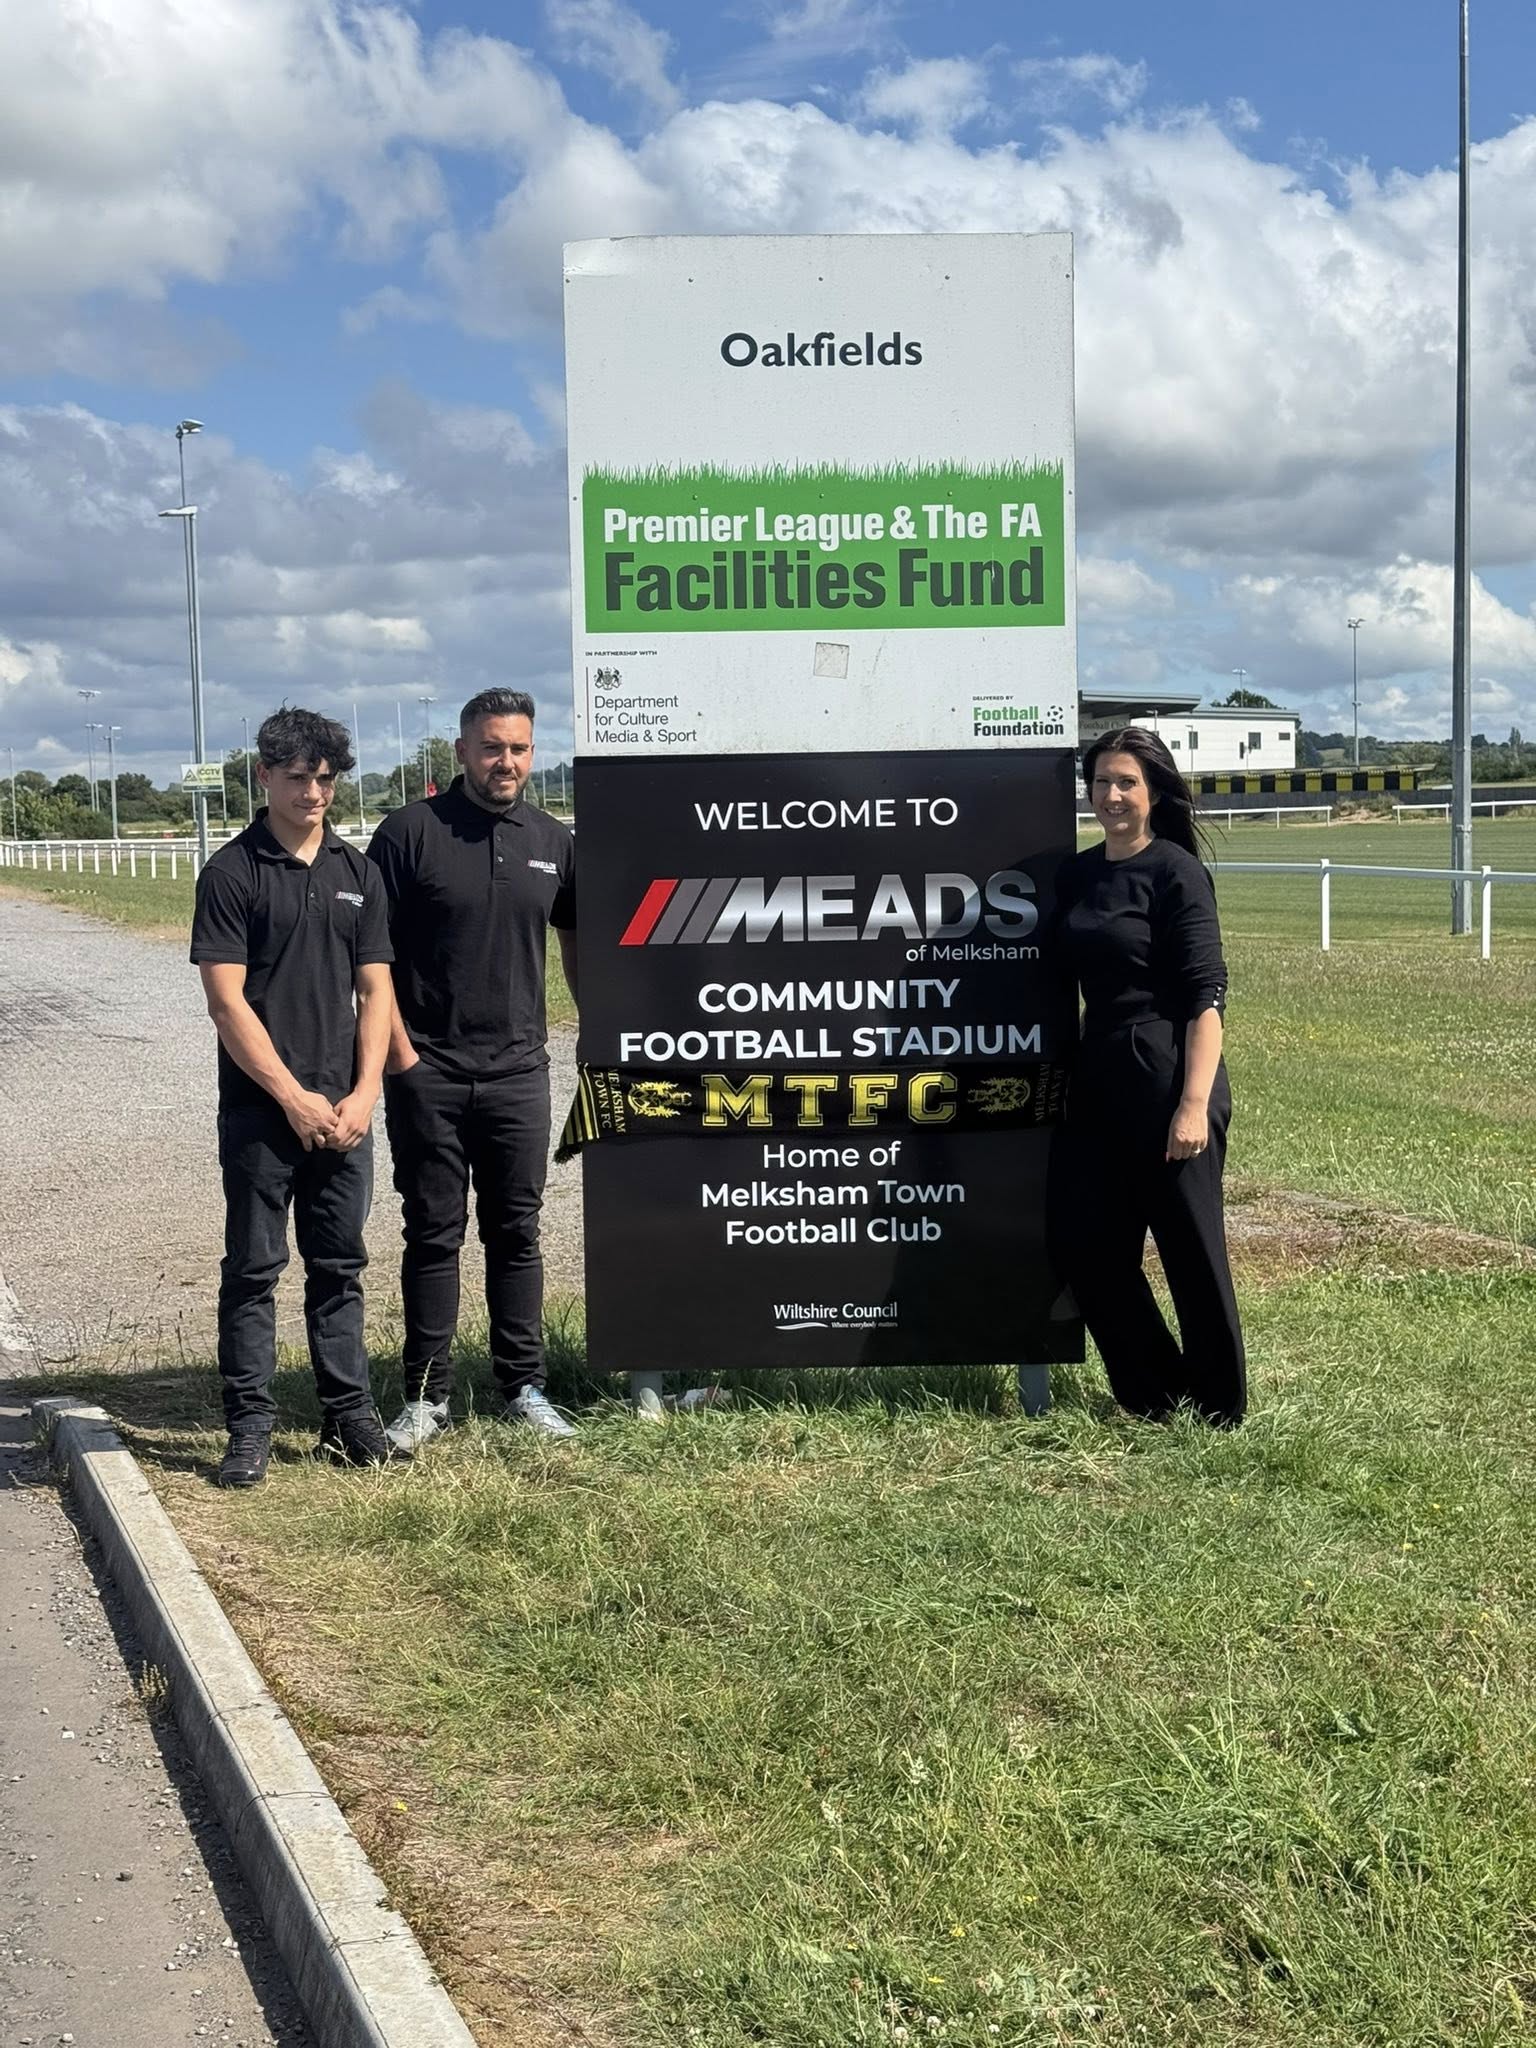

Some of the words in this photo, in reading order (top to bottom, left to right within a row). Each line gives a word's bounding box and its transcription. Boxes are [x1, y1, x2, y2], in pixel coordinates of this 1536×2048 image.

[720, 331, 923, 368] Oakfields
[604, 507, 749, 543] Premier
[755, 506, 885, 552] League
[889, 505, 918, 540] &
[921, 504, 988, 539] The
[1001, 502, 1043, 538] FA
[604, 550, 887, 612] Facilities
[898, 545, 1045, 608] Fund
[594, 695, 679, 712] Department
[973, 705, 1039, 721] Football
[594, 712, 614, 726] for
[617, 711, 669, 726] Culture
[973, 720, 1065, 738] Foundation
[595, 729, 639, 743] Media
[642, 729, 654, 743] &
[657, 728, 697, 745] Sport
[200, 768, 220, 776] CCTV
[694, 798, 897, 831] WELCOME
[906, 797, 959, 826] TO
[705, 869, 1041, 945] MEADS
[905, 944, 927, 962] of
[932, 943, 1040, 961] Melksham
[698, 978, 960, 1014] COMMUNITY
[620, 1028, 842, 1062] FOOTBALL
[852, 1024, 1041, 1058] STADIUM
[593, 1072, 611, 1109] TOWN
[701, 1071, 958, 1127] MTFC
[601, 1113, 612, 1129] FC
[763, 1143, 860, 1169] Home
[868, 1140, 902, 1167] of
[702, 1180, 869, 1208] Melksham
[876, 1179, 965, 1204] Town
[726, 1217, 857, 1245] Football
[866, 1216, 942, 1243] Club
[773, 1302, 838, 1320] Wiltshire
[842, 1302, 897, 1319] Council
[849, 1320, 876, 1330] everybody
